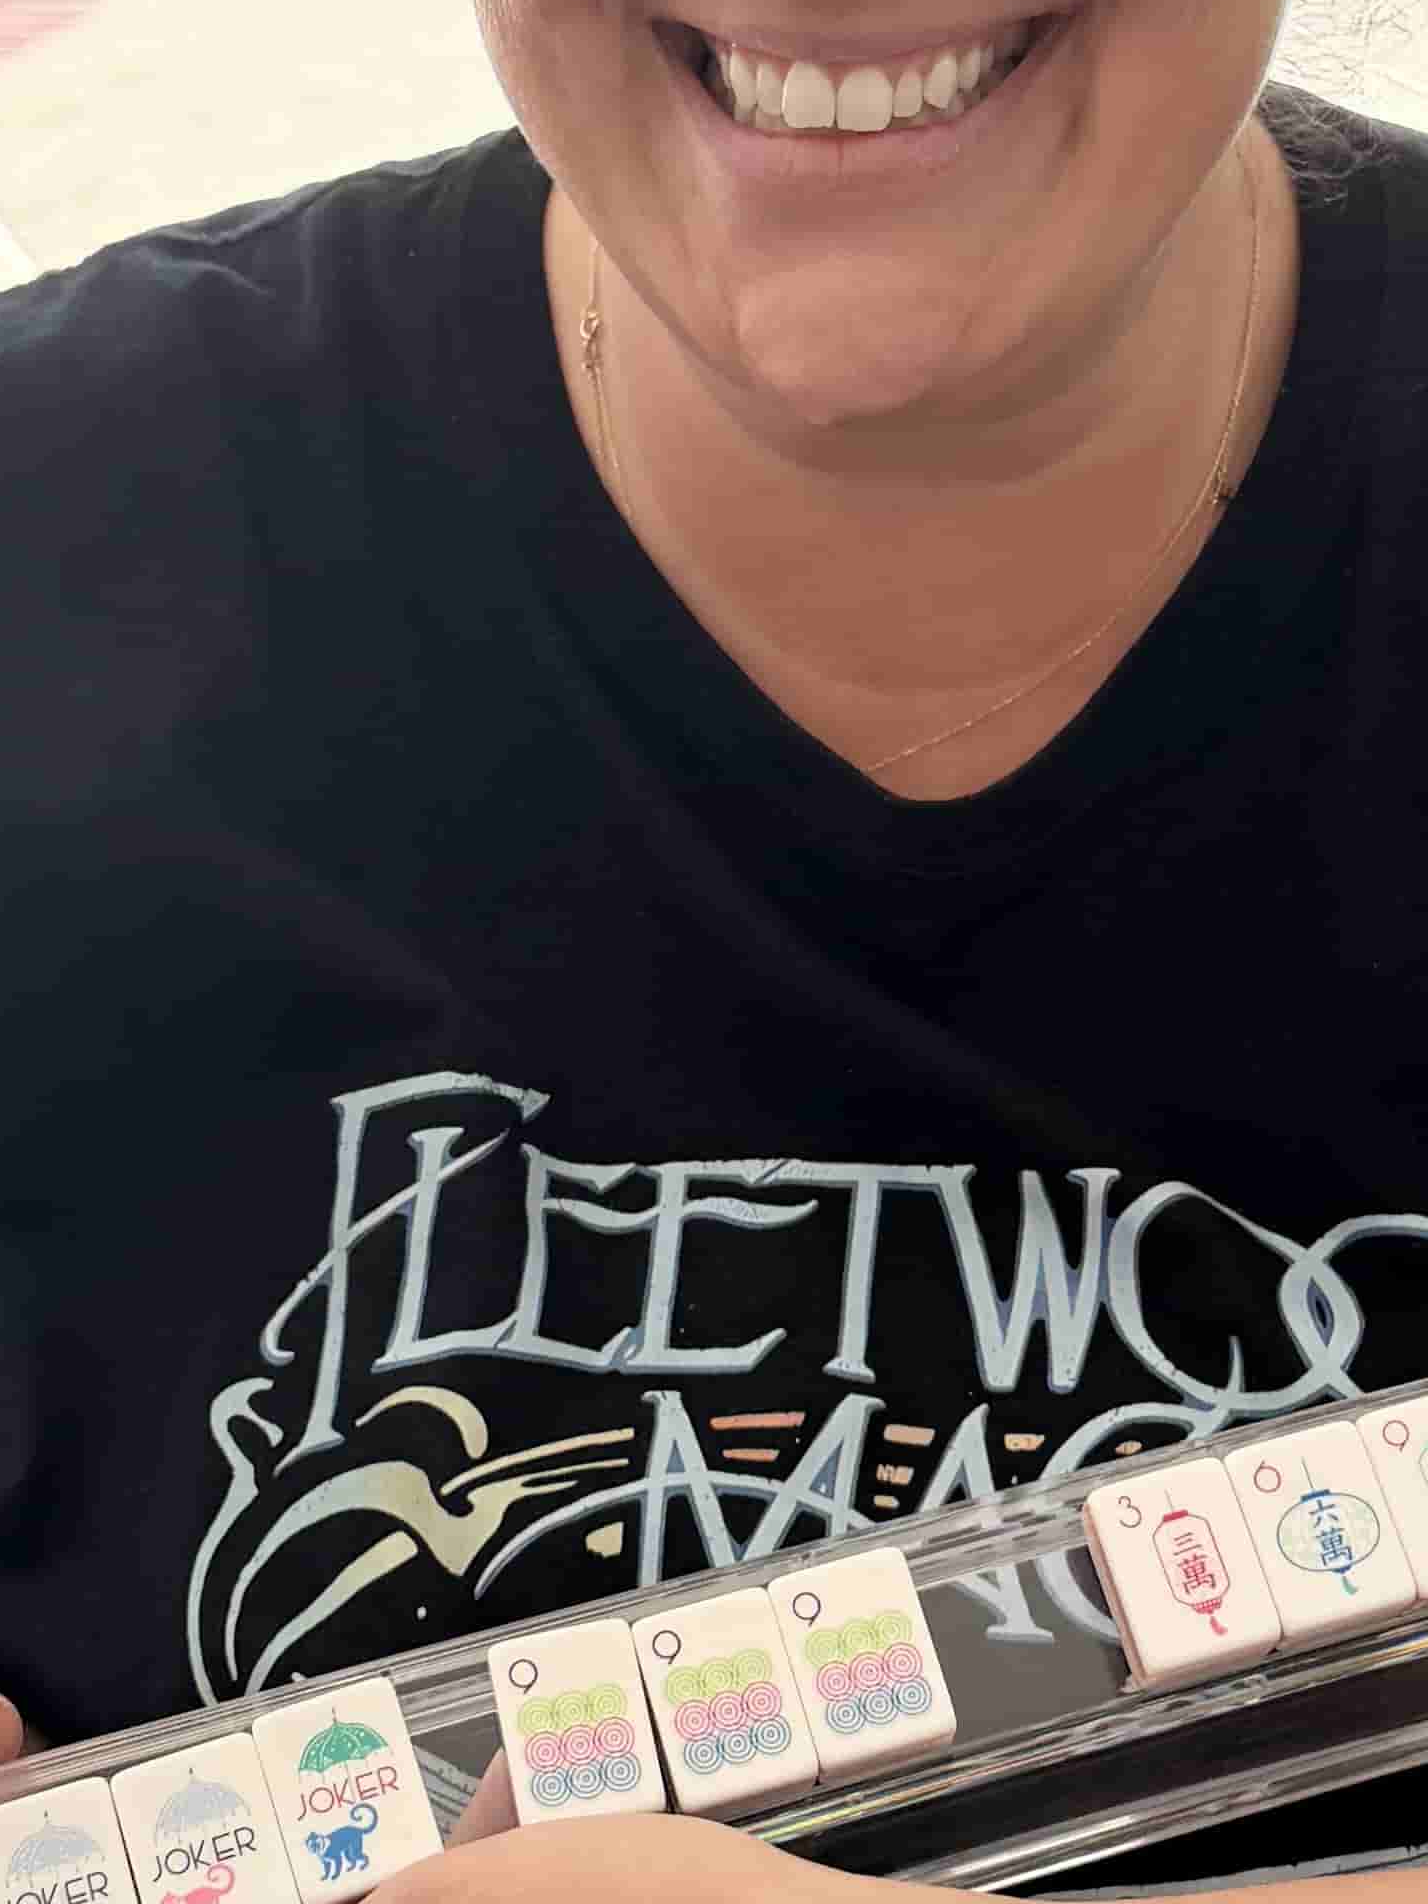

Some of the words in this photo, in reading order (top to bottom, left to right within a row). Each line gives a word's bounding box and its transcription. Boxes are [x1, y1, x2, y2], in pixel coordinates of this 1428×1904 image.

[1382, 1418, 1410, 1453] 9
[1253, 1458, 1282, 1494] 6
[1116, 1494, 1143, 1529] 3
[1309, 1498, 1353, 1566] 六萬
[1171, 1530, 1218, 1596] 三萬
[791, 1590, 822, 1628] 9
[651, 1629, 682, 1665] 9
[508, 1658, 539, 1695] 9
[296, 1764, 400, 1822] JOKER
[152, 1825, 258, 1883] JOKER
